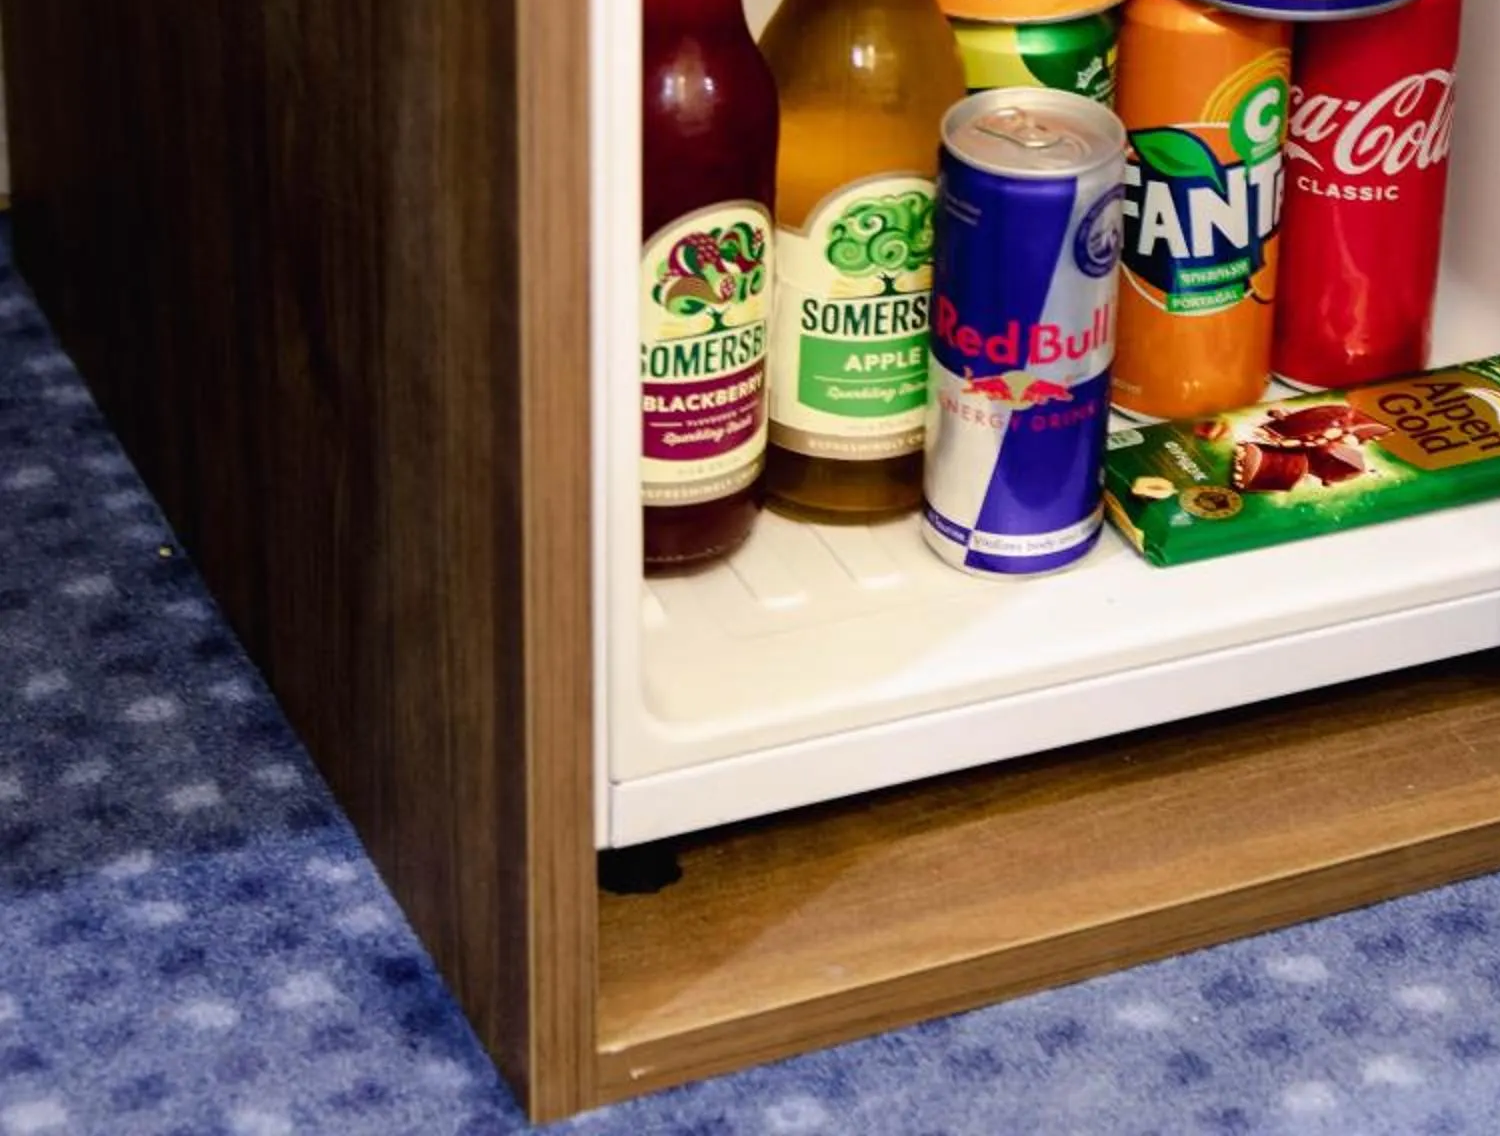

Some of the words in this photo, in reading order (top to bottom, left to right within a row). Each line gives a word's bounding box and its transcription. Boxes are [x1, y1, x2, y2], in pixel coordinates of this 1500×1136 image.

[1296, 175, 1400, 202] CLASSIC
[800, 297, 927, 337] SOMERS
[936, 295, 1021, 366] Red
[1028, 303, 1110, 365] Bull
[640, 324, 766, 380] OMERSB
[844, 347, 922, 373] APPLE
[641, 371, 763, 413] BLACKBERRY
[1377, 392, 1470, 456] Gold
